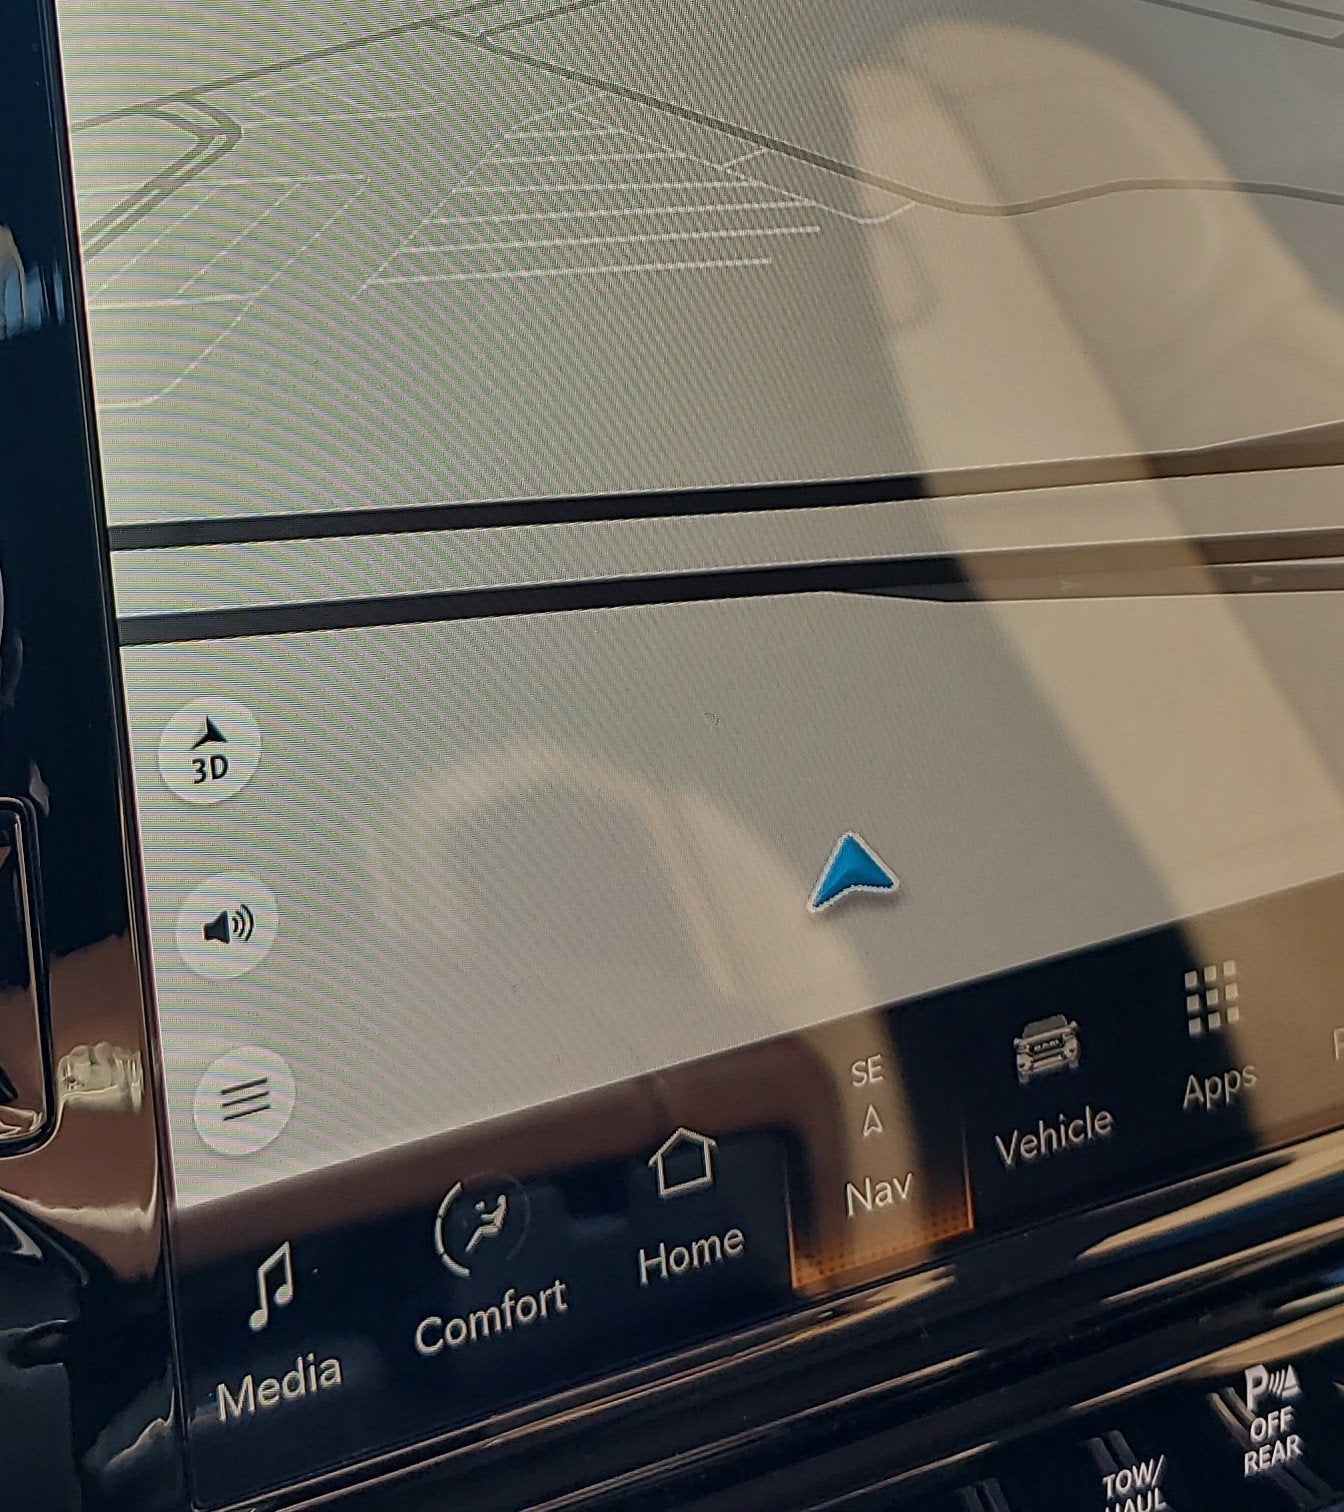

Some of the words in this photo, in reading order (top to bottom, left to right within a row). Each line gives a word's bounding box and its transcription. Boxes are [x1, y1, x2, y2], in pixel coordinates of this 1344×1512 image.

[191, 753, 230, 785] 3D
[850, 1053, 885, 1088] SE
[1182, 1063, 1258, 1113] Apps
[994, 1105, 1115, 1169] Vehicle
[845, 1171, 914, 1219] Nav
[638, 1226, 746, 1286] Home
[414, 1278, 569, 1356] Comfort
[215, 1351, 344, 1423] Media
[1249, 1404, 1296, 1444] OFF
[1102, 1453, 1166, 1502] TOW/
[1244, 1433, 1304, 1478] REAR
